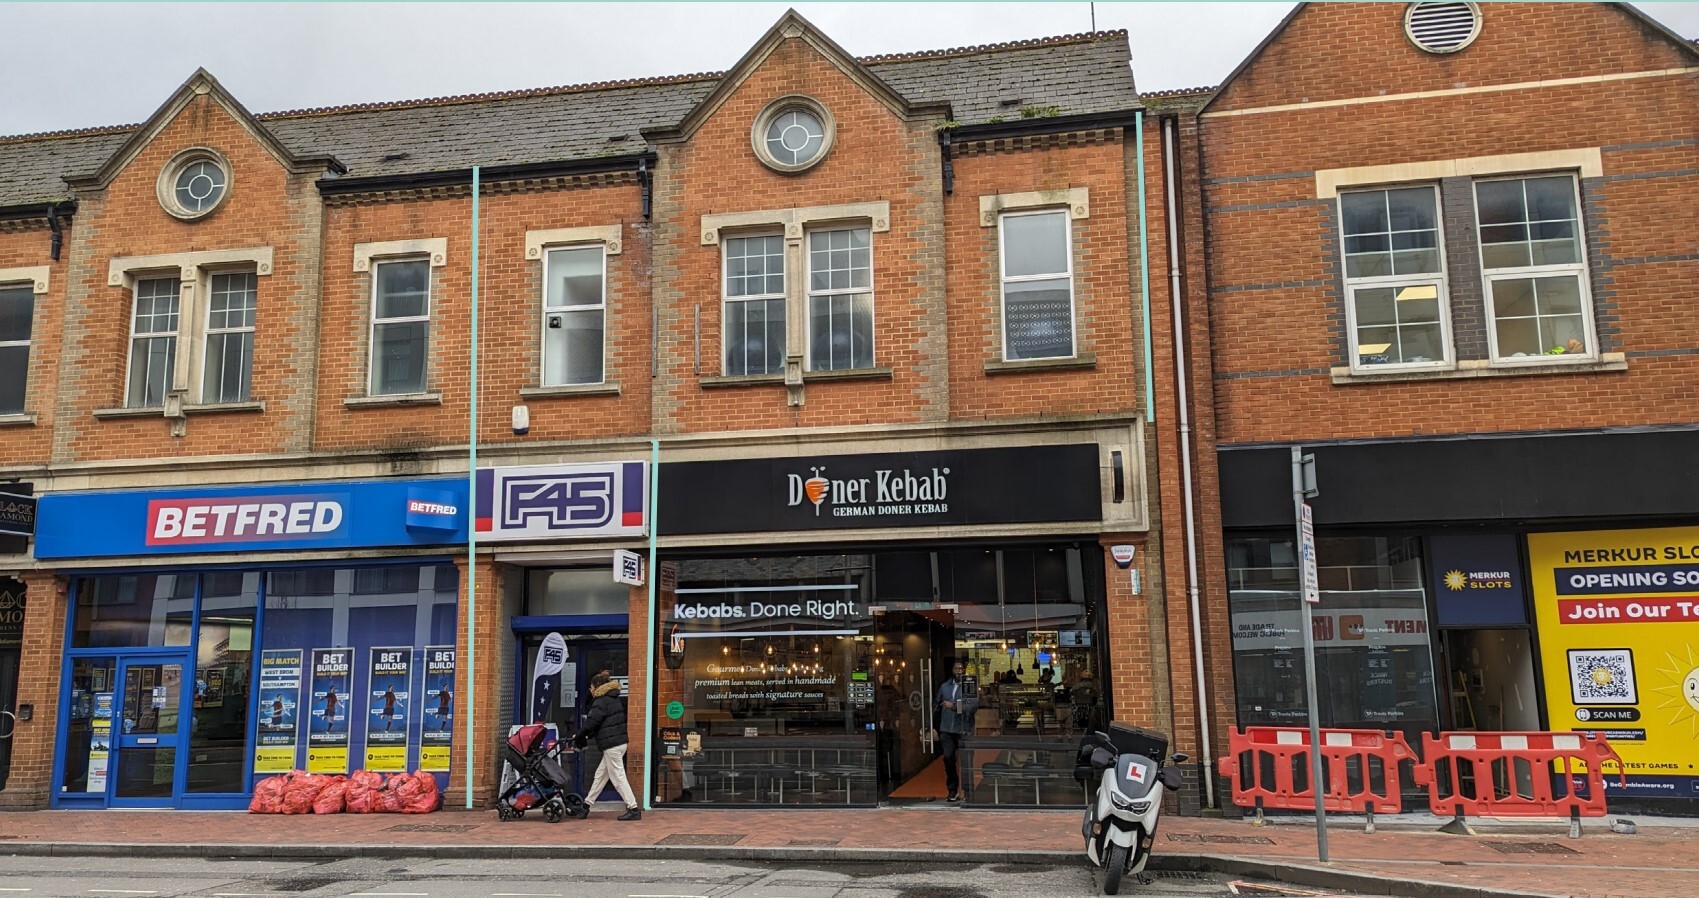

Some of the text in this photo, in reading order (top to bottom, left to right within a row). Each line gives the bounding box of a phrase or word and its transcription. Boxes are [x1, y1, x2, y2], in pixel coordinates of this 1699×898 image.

[501, 472, 614, 529] F45
[410, 502, 457, 515] BETFRED
[833, 503, 948, 516] GERMAN DONER KEBAB
[154, 501, 343, 538] BETFRED
[1564, 547, 1657, 563] MERKUR
[1469, 571, 1510, 579] MERKUR
[1570, 571, 1699, 588] OPENING SO
[1470, 581, 1511, 589] SLOTS
[674, 600, 859, 619] Kebabs. Done Right.
[1568, 603, 1620, 619] Join
[1626, 603, 1671, 617] Our
[323, 654, 344, 664] BET
[381, 653, 402, 662] BET
[435, 652, 455, 661] BET
[543, 646, 563, 664] F45
[707, 664, 745, 673] Gourme
[695, 679, 730, 689] premium
[794, 675, 836, 685] handmade
[750, 690, 764, 698] with
[765, 690, 803, 701] signature
[1593, 711, 1632, 719] SCAN ME
[1131, 766, 1142, 779] L
[1610, 782, 1675, 790] BeGmbleAware.org
